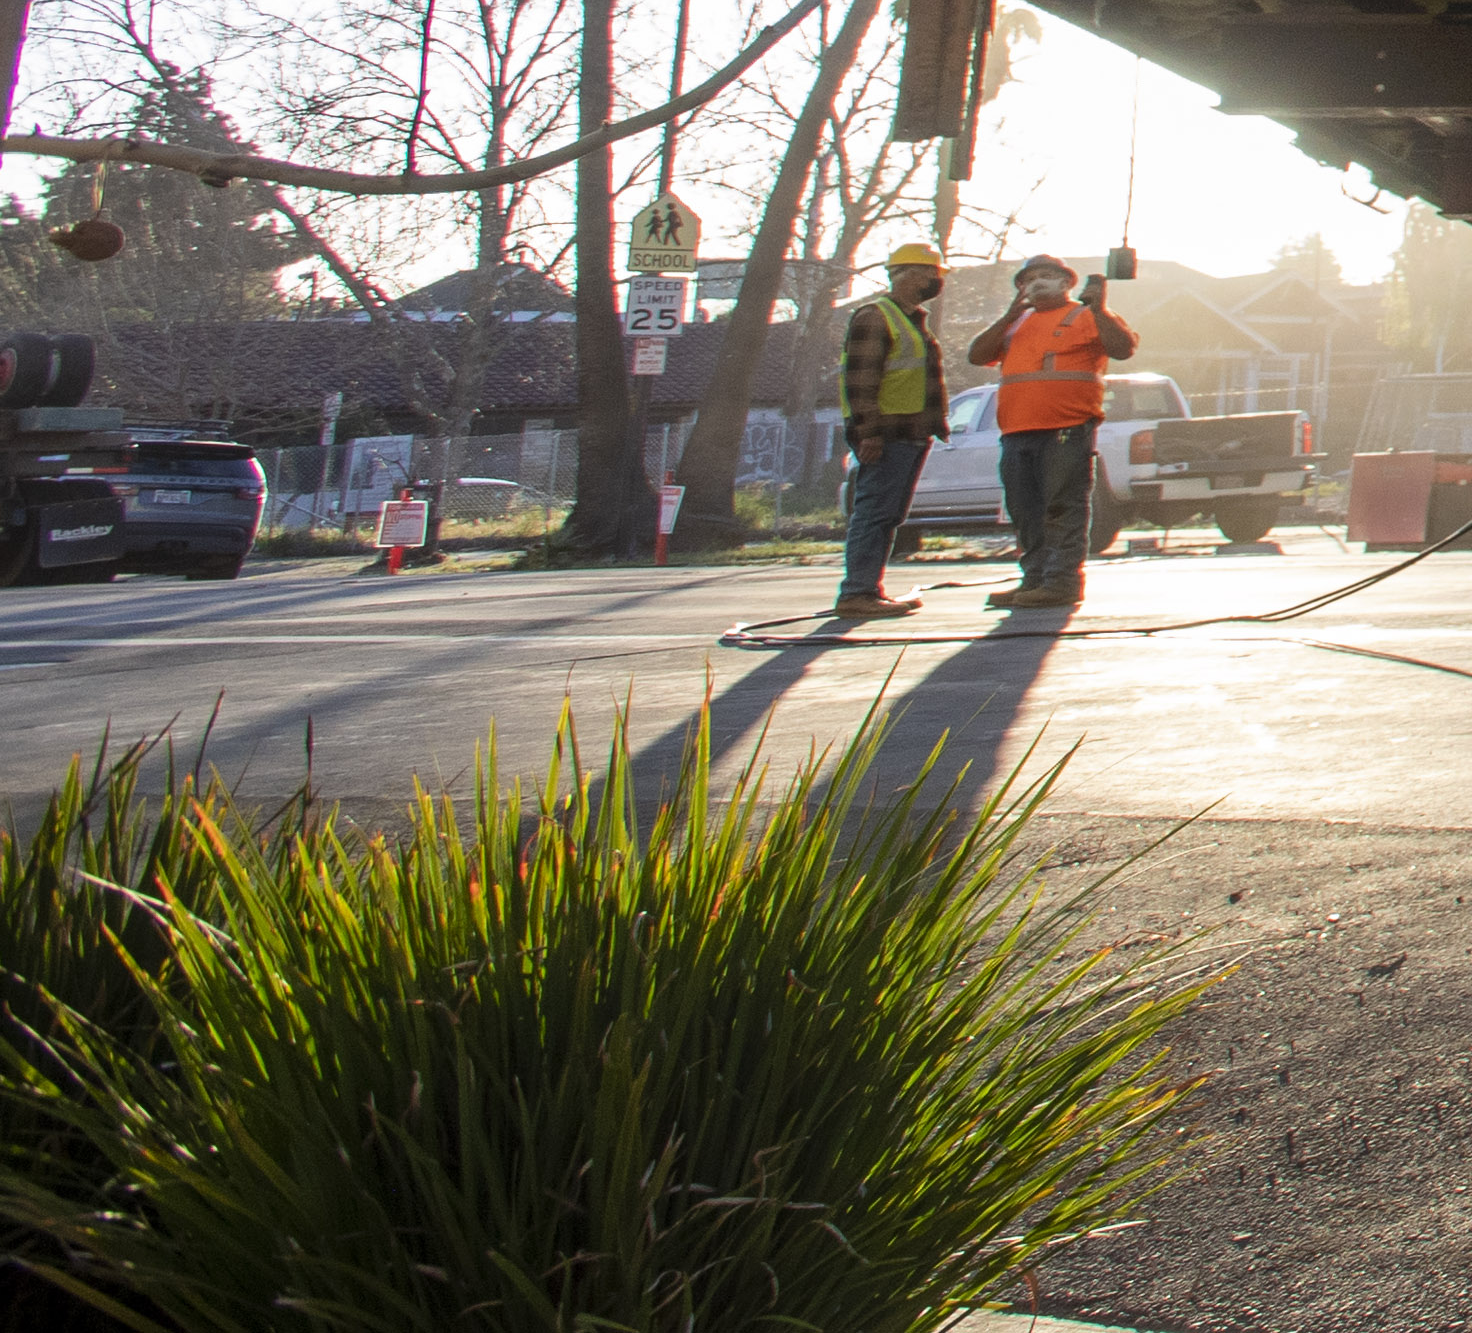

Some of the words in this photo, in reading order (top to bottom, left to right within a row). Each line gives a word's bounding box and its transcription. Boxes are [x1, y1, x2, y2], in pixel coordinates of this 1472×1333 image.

[633, 253, 692, 268] SCHOOL
[633, 280, 684, 291] SPEED
[637, 294, 676, 305] LIMIT
[631, 308, 678, 331] 25
